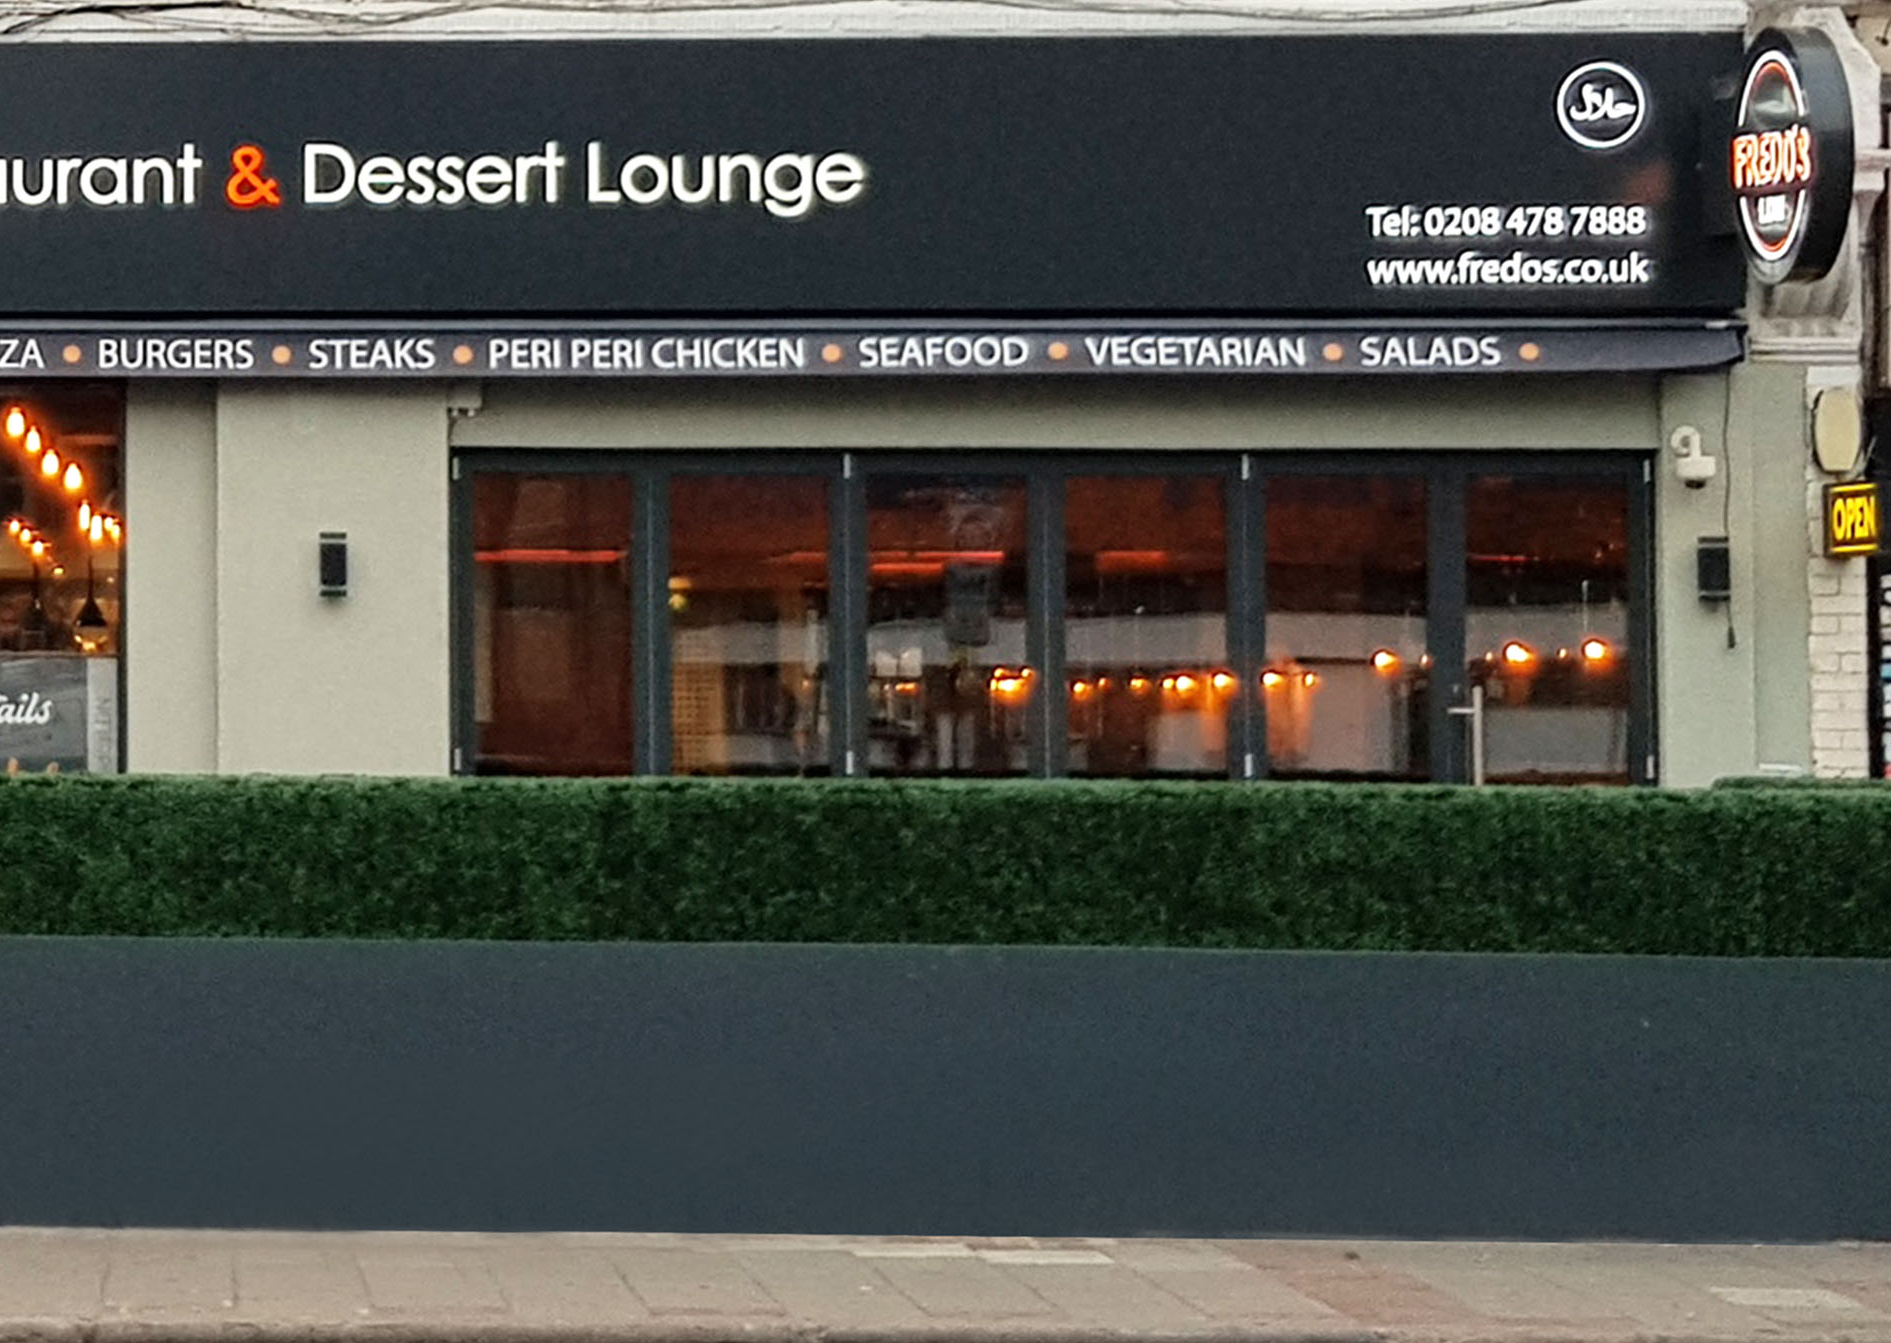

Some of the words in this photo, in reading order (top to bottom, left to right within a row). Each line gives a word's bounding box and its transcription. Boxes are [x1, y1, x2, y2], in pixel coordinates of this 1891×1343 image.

[224, 144, 282, 209] &
[303, 141, 566, 205] Dessert
[588, 141, 867, 218] Lounge
[1365, 205, 1423, 237] Tel:
[1423, 206, 1501, 236] 0208
[1505, 206, 1565, 236] 478
[1569, 206, 1648, 236] 7888
[1366, 250, 1650, 285] www.fredos.co.uk
[98, 338, 255, 369] BURGERS
[308, 338, 437, 369] STEAKS
[489, 338, 562, 369] PERI
[571, 338, 644, 369] PERI
[651, 337, 806, 369] CHICKEN
[858, 336, 1030, 369] SEAFOOD
[1084, 336, 1308, 368] VEGETARIAN
[1359, 336, 1502, 368] SALADS
[1832, 496, 1877, 541] OPEN
